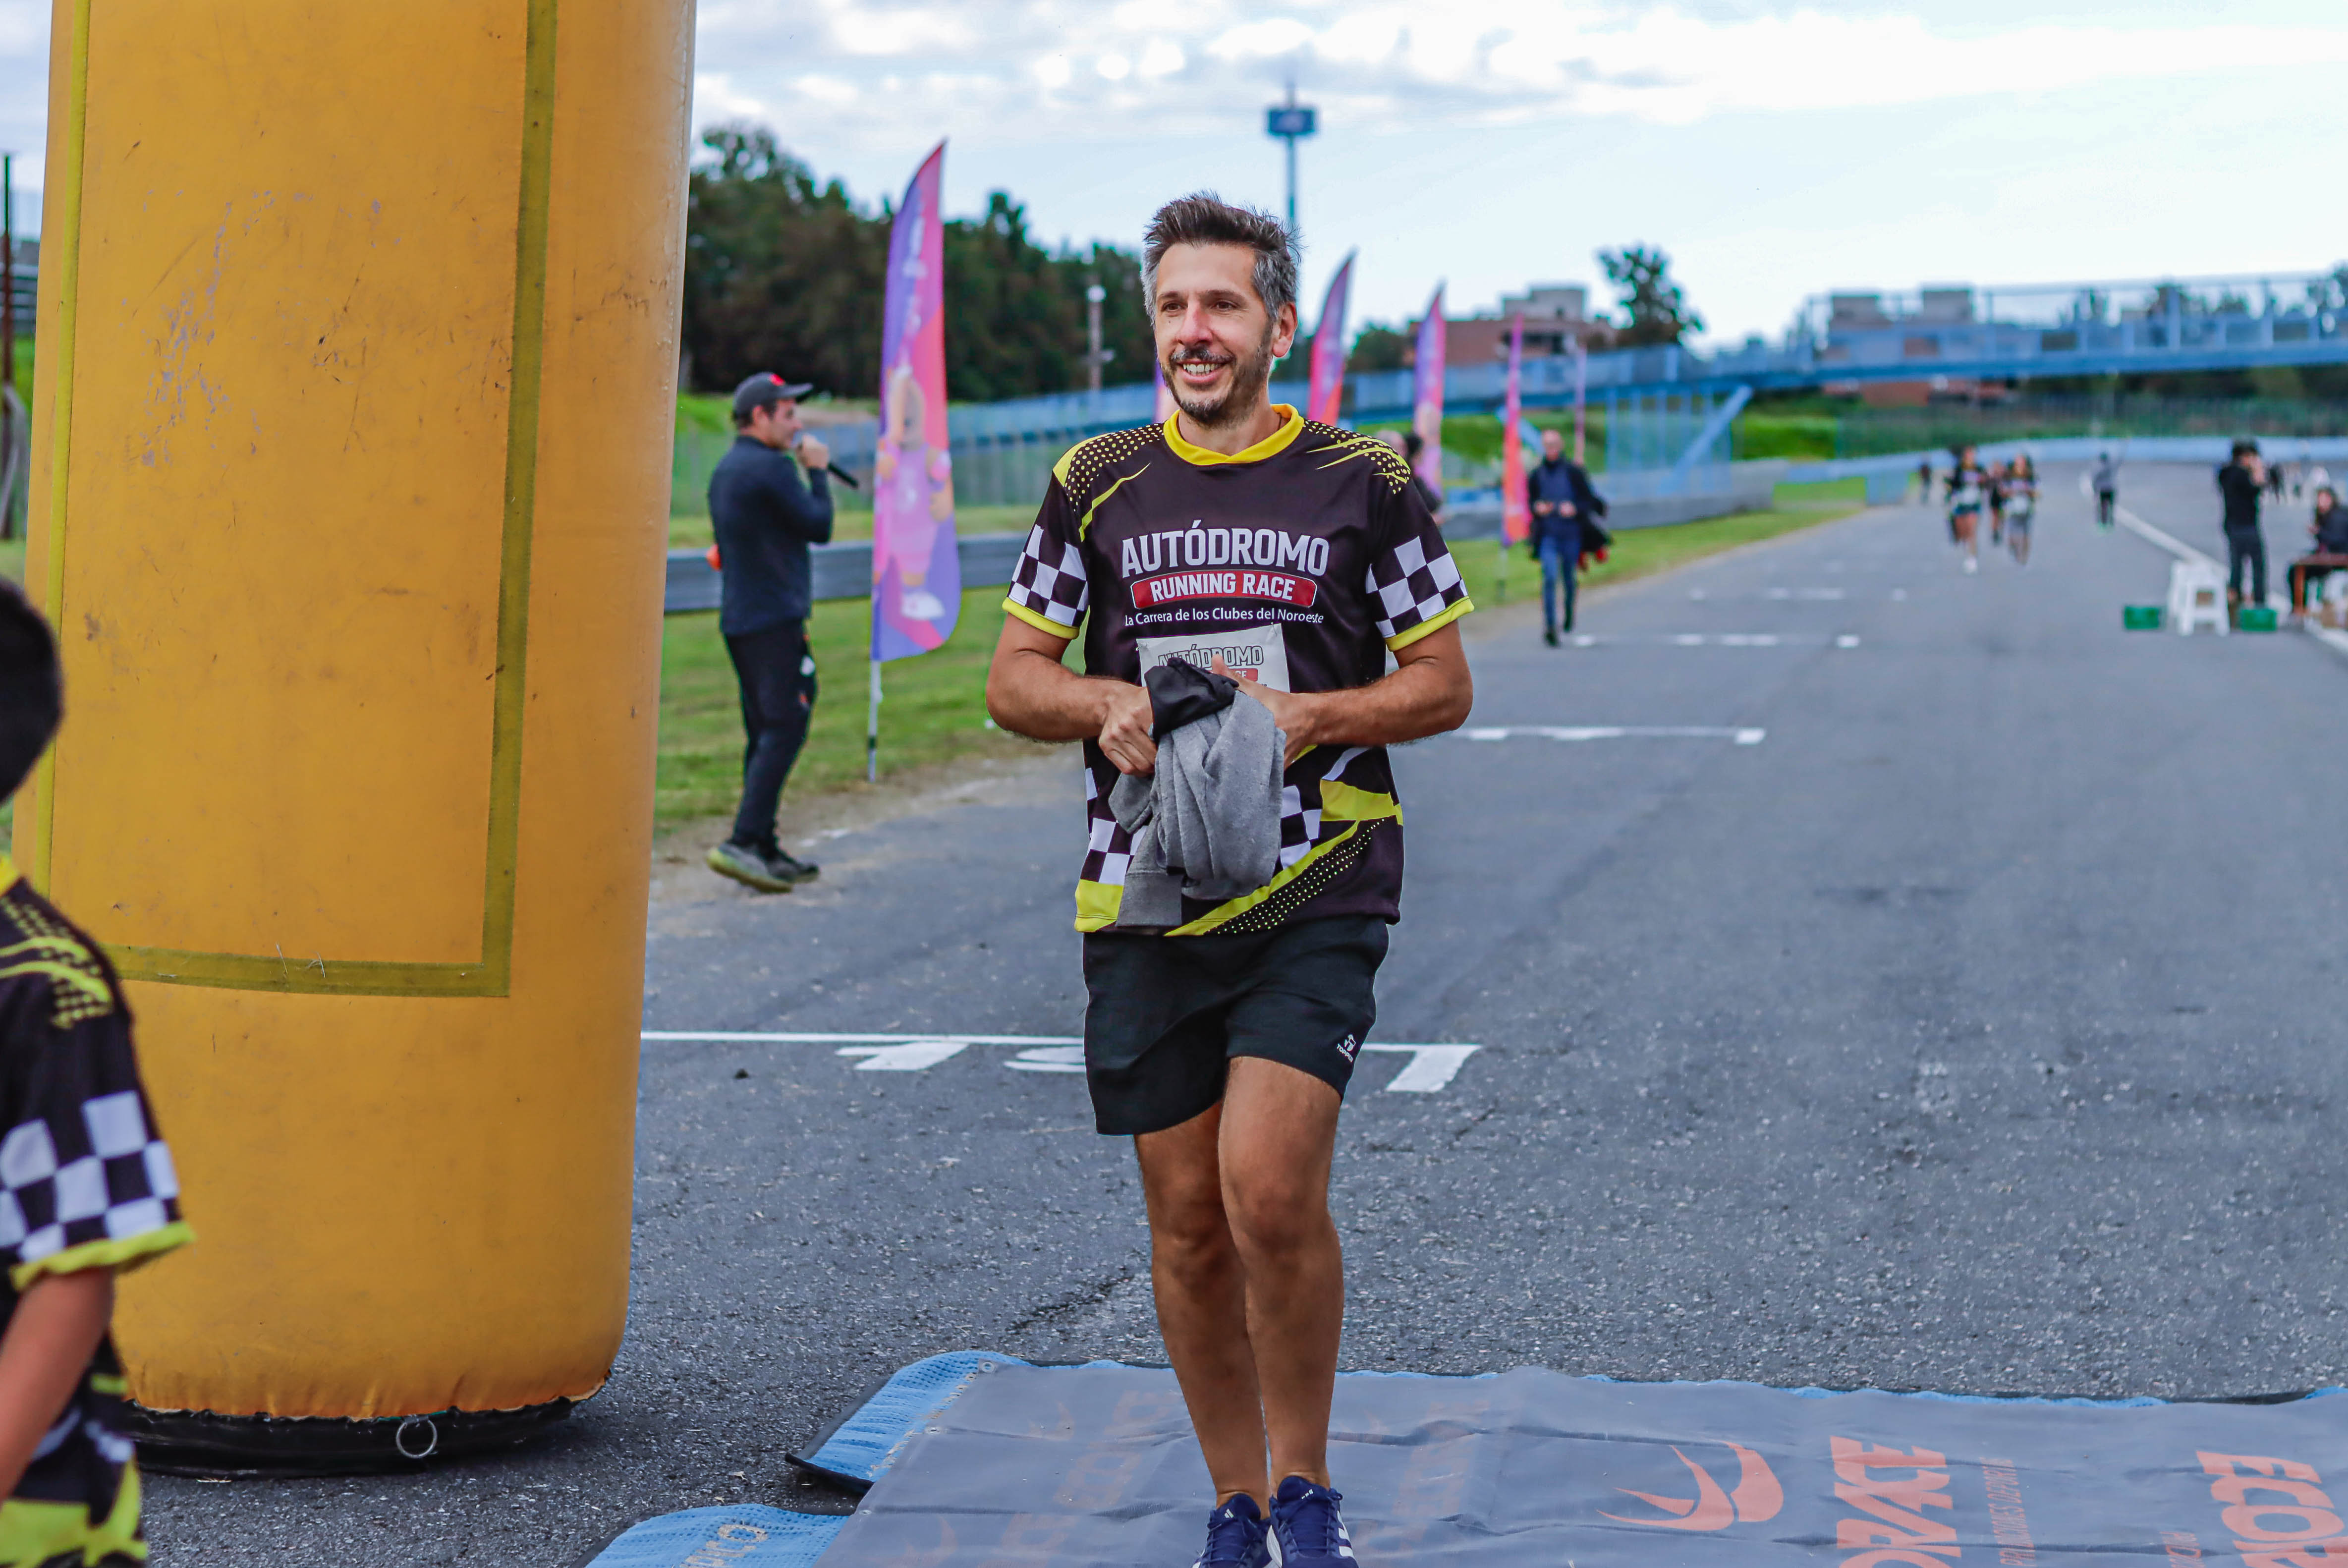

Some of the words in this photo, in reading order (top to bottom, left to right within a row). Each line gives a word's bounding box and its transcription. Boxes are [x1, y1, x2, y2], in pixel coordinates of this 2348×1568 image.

[1122, 519, 1330, 578] AUTÓDROMO
[1150, 572, 1236, 603] RUNNING
[1242, 573, 1295, 600] RACE
[1125, 615, 1134, 626] La
[1135, 613, 1173, 624] Carrera
[1175, 609, 1190, 621] de
[1192, 608, 1210, 620] los
[1212, 607, 1253, 619] Clubes
[1256, 607, 1275, 619] del
[1278, 609, 1324, 623] Noroeste
[1158, 644, 1264, 669] ATÓDOMO
[2196, 1451, 2348, 1568] ECOR
